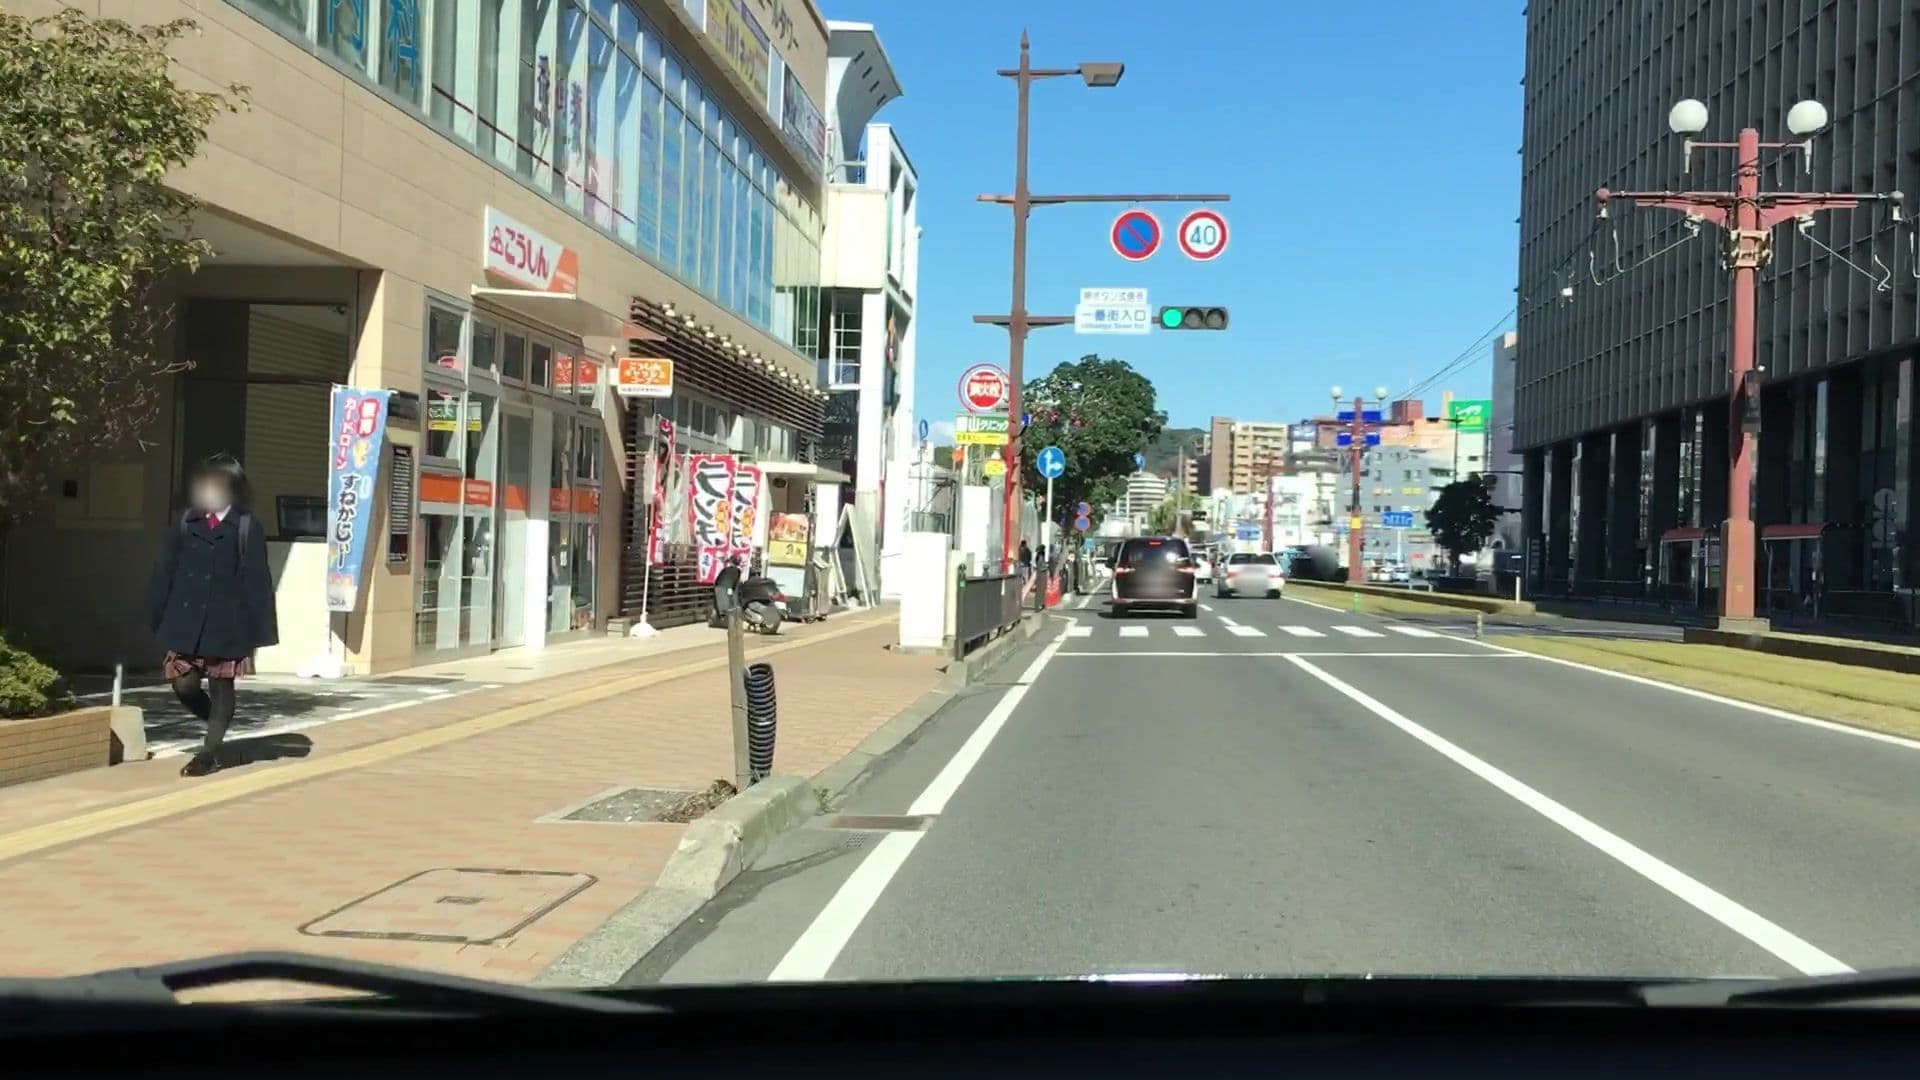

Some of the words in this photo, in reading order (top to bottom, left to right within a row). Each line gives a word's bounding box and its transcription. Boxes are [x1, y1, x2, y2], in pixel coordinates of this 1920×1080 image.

[505, 227, 550, 281] こうしん
[1190, 225, 1216, 246] 40
[336, 397, 357, 470] カードローン
[694, 461, 730, 547] ランチ
